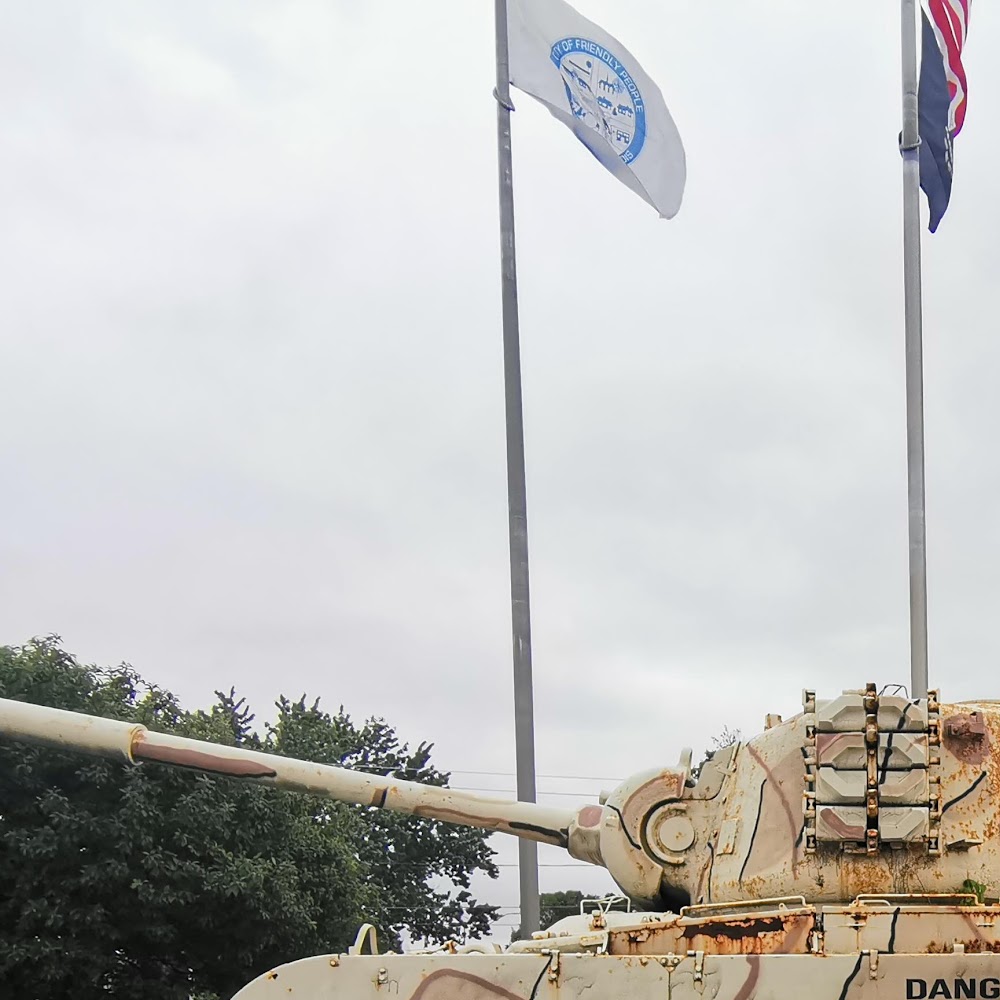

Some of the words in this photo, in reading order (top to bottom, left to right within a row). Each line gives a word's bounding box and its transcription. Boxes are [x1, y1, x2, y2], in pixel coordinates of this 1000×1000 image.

[561, 39, 573, 51] OF
[575, 39, 622, 71] FRIENDLY
[619, 70, 643, 113] PEOPLE
